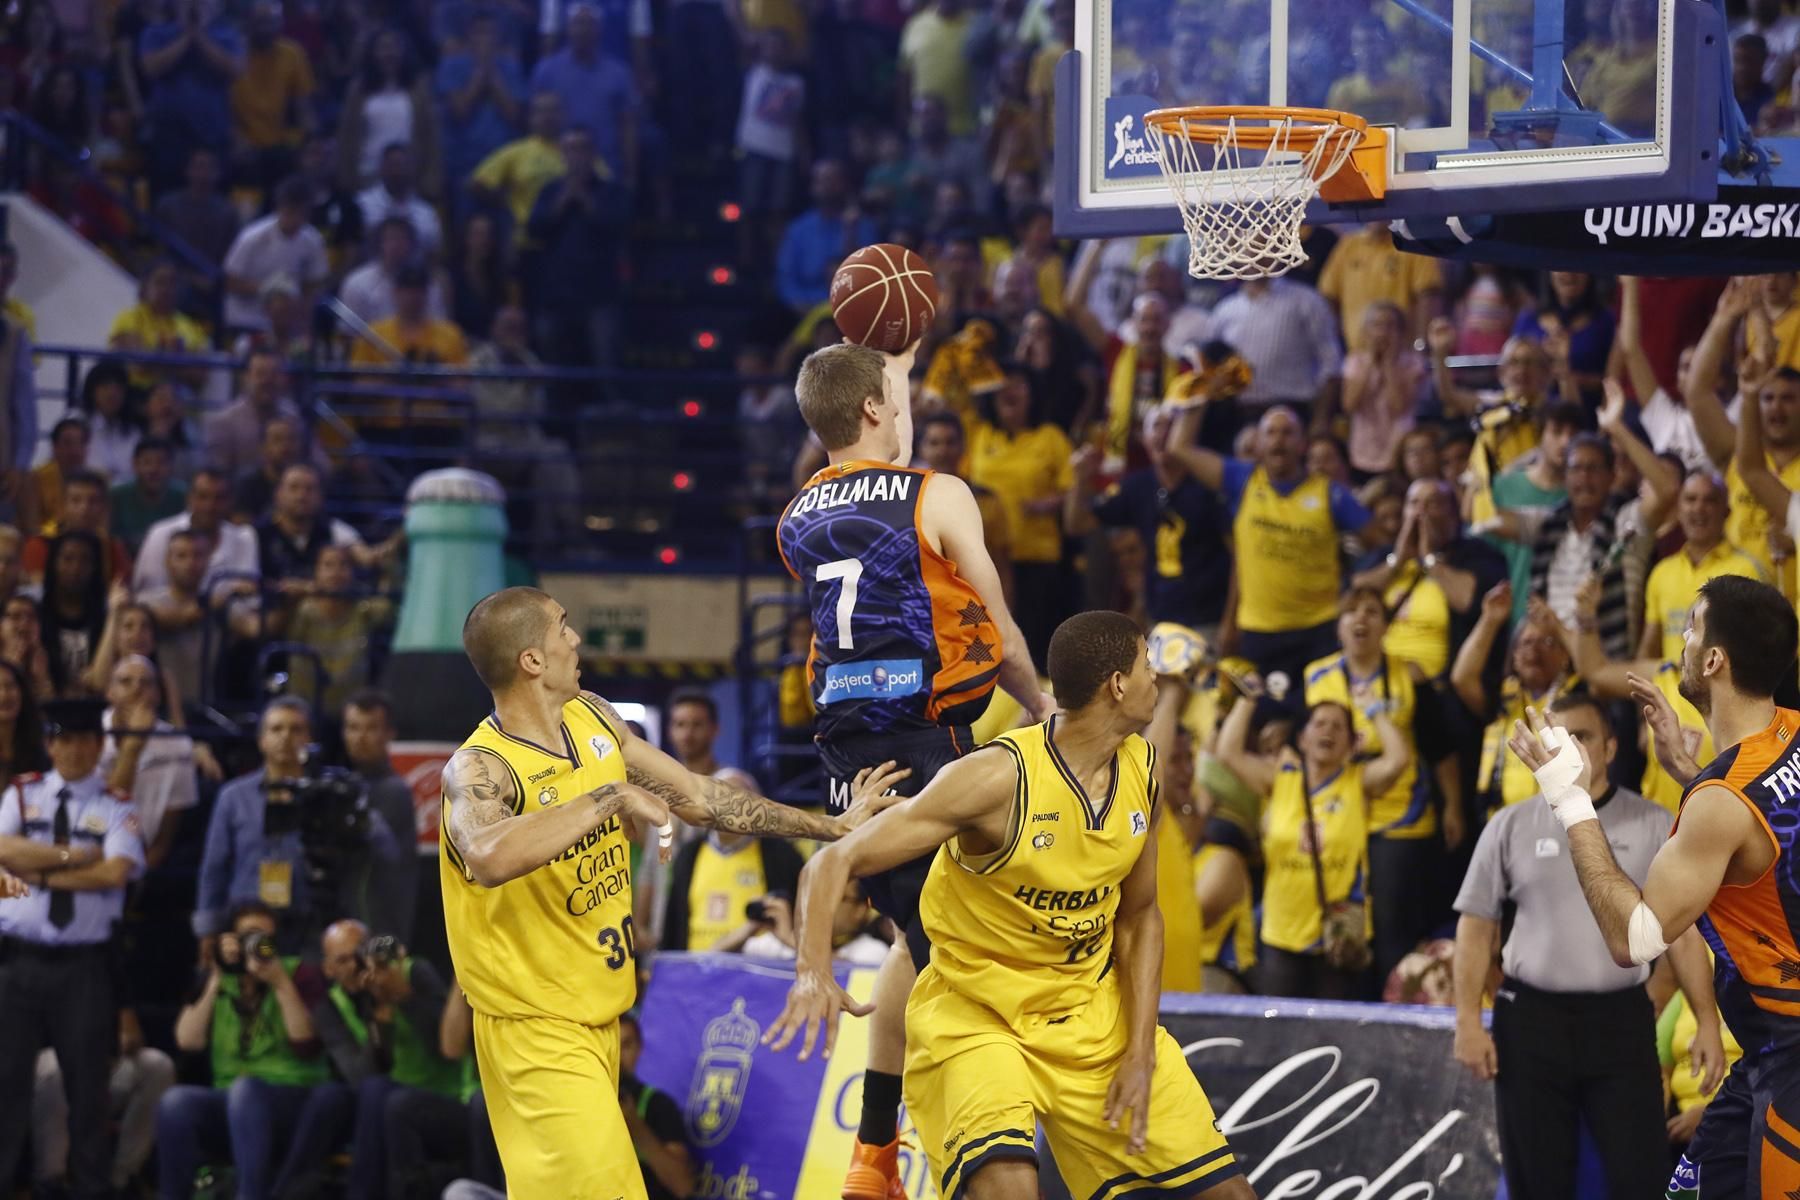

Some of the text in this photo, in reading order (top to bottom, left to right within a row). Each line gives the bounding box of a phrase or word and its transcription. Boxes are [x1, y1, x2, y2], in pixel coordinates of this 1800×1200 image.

[1584, 203, 1800, 245] QUINI BASK
[815, 557, 865, 651] 7
[527, 765, 557, 785] SPALDING
[545, 814, 621, 867] ERBAL
[576, 843, 625, 885] Gran
[597, 913, 635, 971] 30
